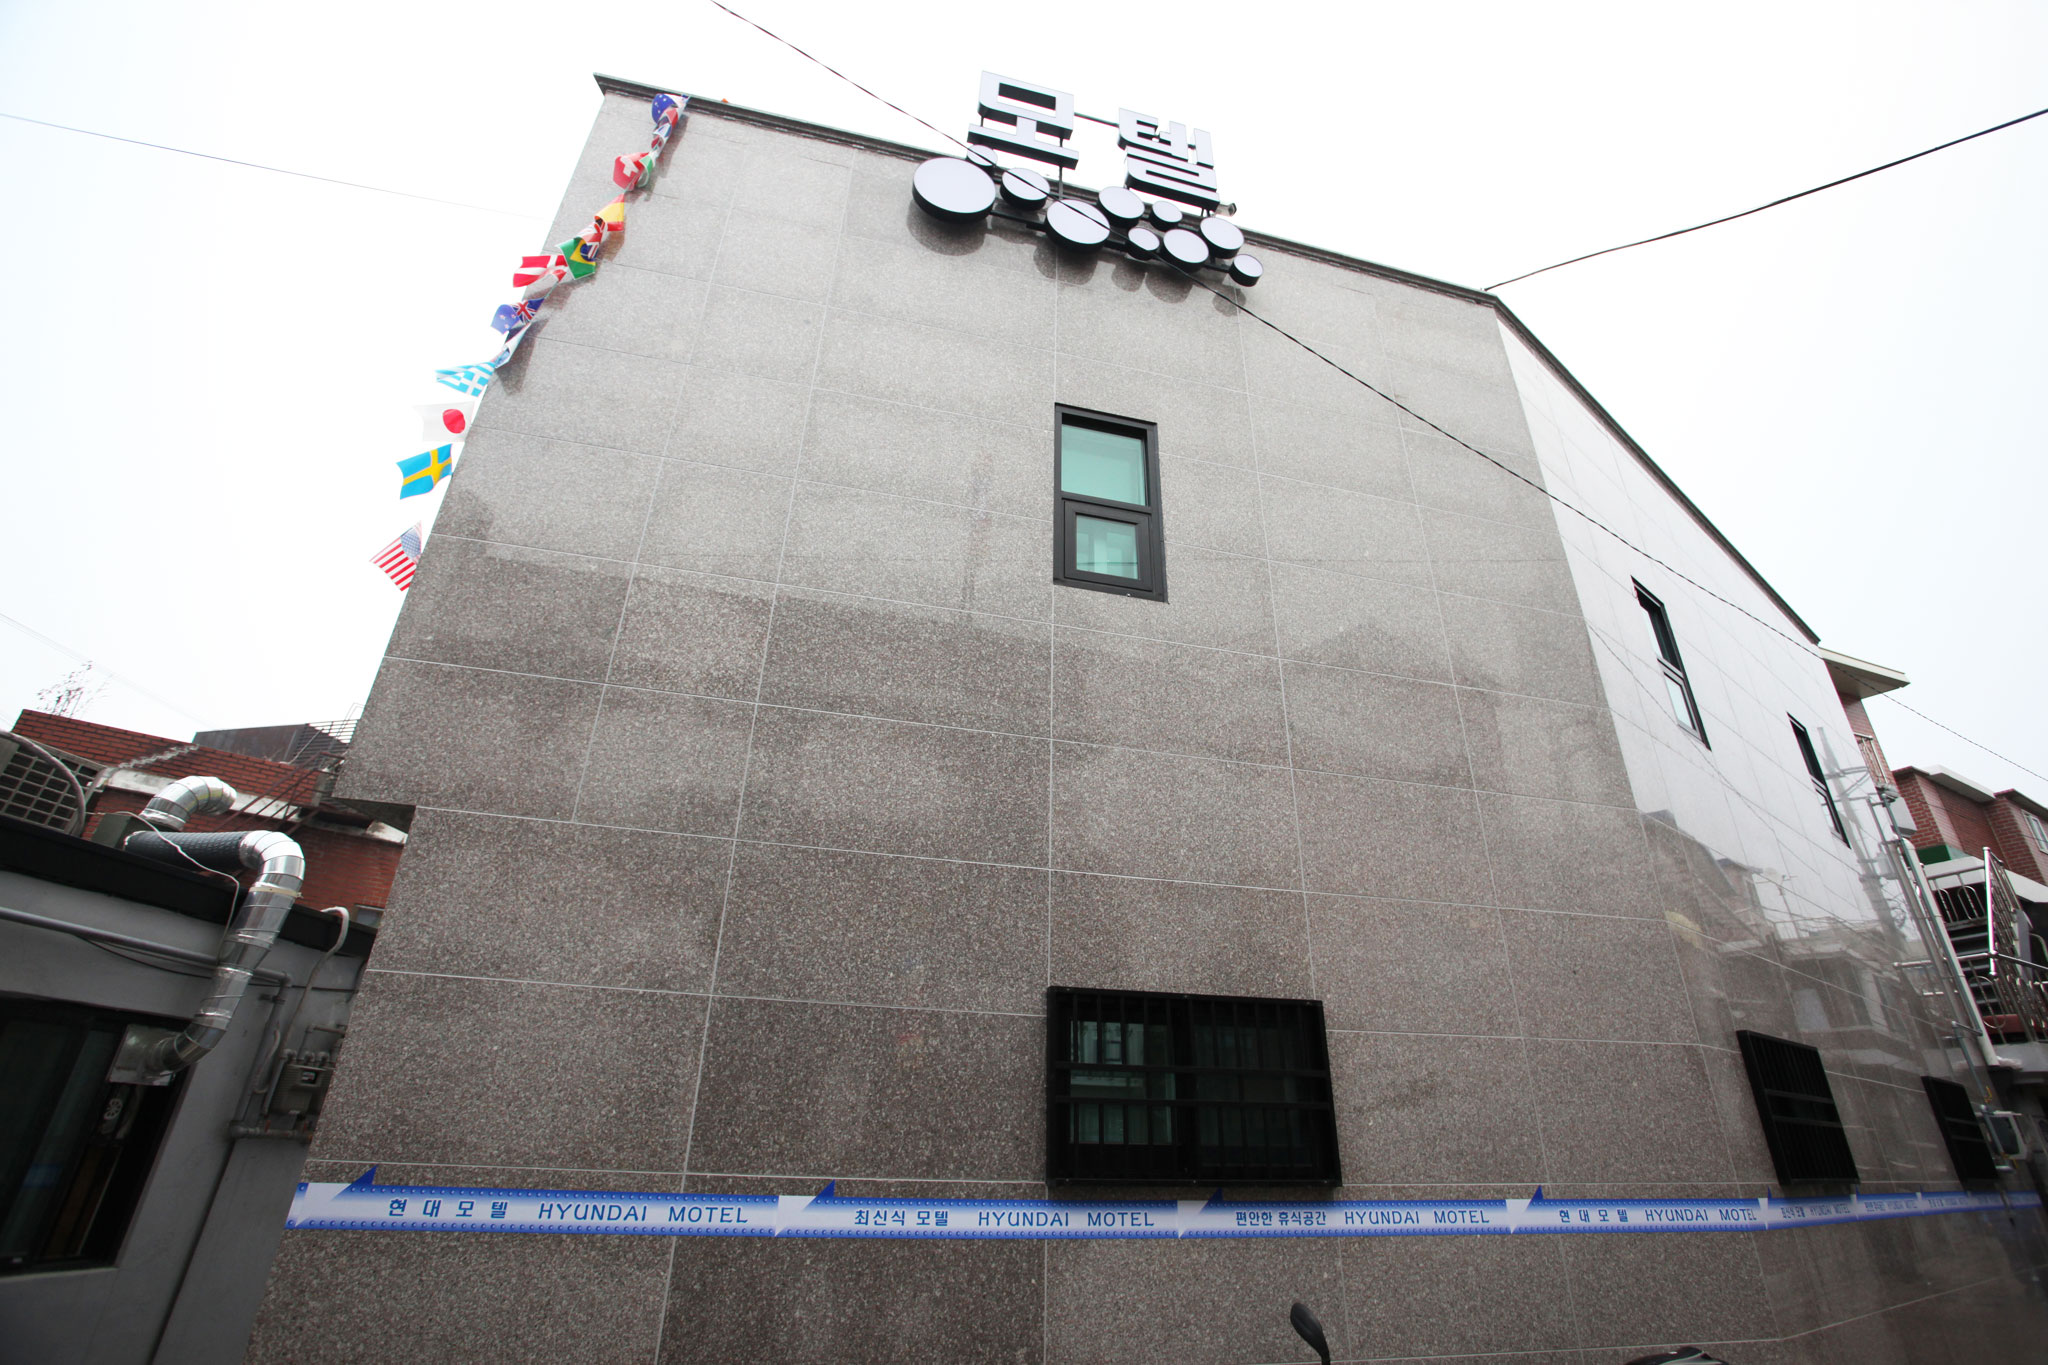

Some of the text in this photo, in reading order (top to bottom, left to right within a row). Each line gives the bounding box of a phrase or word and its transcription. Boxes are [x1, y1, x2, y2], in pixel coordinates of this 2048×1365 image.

[968, 70, 1220, 211] 모텔
[538, 1202, 647, 1222] HYUNDAI
[668, 1206, 749, 1224] MOTEL
[854, 1208, 1155, 1228] 최신식 모텔 HYUNDAI MOTEL
[1344, 1210, 1420, 1225] HYUNDAI
[1434, 1209, 1490, 1224] MOTEL
[1645, 1208, 1709, 1222] HYUNDAI
[1719, 1208, 1757, 1222] MOTEL
